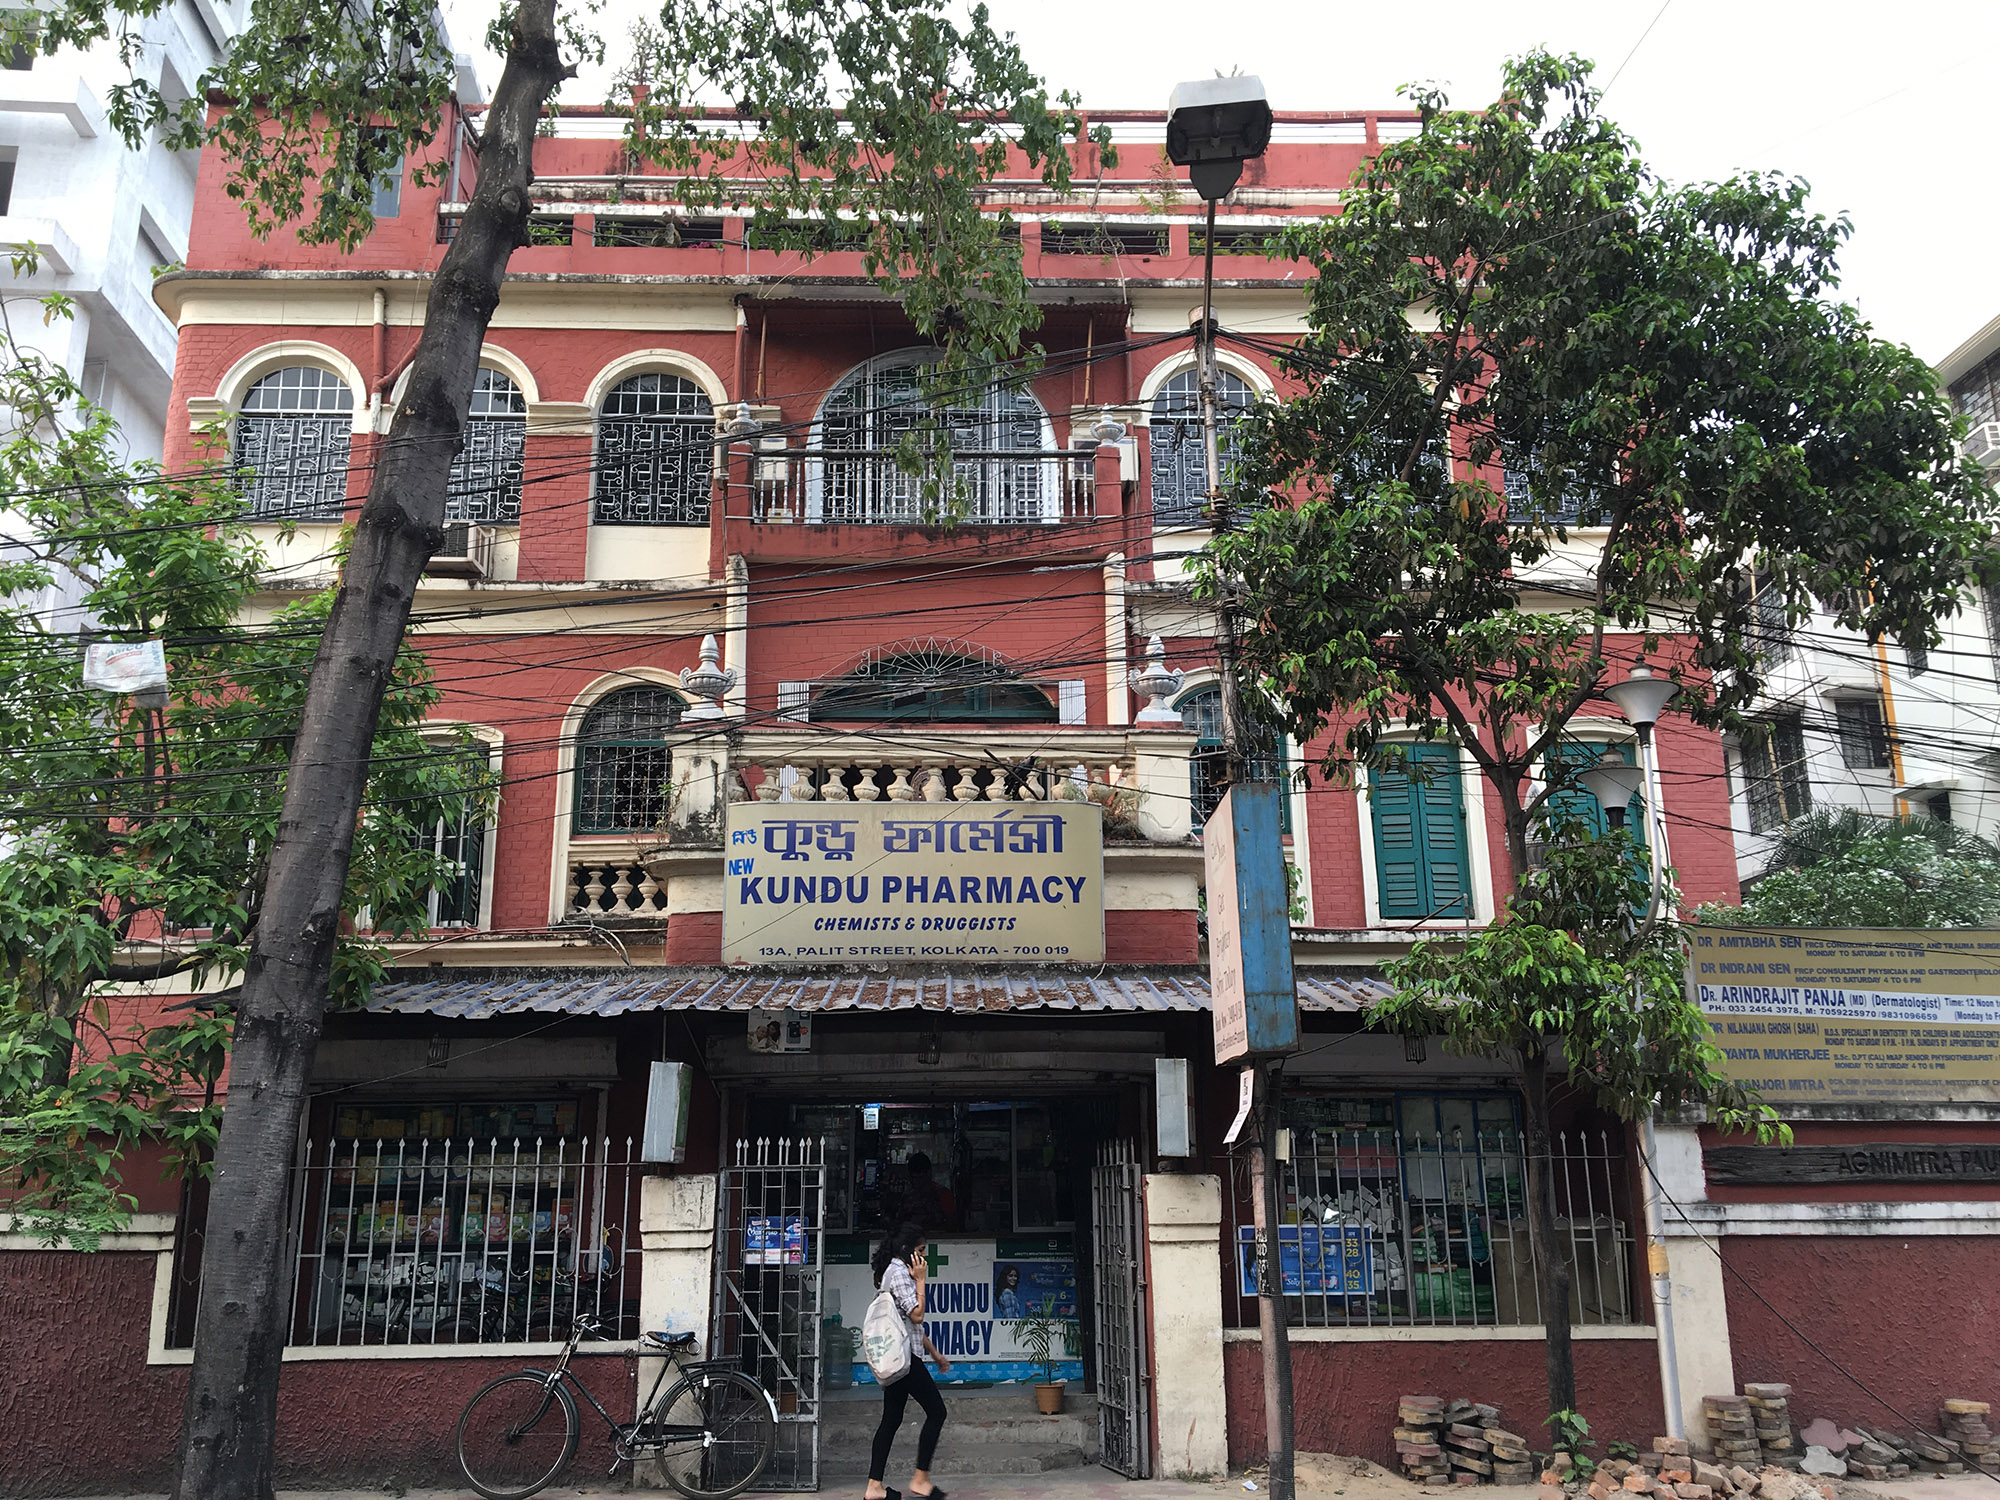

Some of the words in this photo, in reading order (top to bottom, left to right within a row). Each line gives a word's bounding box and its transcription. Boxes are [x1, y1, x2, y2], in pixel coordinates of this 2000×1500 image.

[728, 858, 755, 876] NEW
[740, 876, 869, 905] KUNDU
[882, 876, 1086, 904] PHARMACY
[814, 917, 901, 931] CHEMISTS
[904, 918, 915, 930] &
[921, 917, 1016, 931] DRUGGISTS
[1698, 936, 1713, 947] DR
[1719, 937, 1776, 948] AMITABHA
[1780, 937, 1802, 948] SEN
[759, 947, 792, 957] 13A,
[797, 947, 844, 955] PALIT
[848, 947, 916, 956] STREET,
[921, 946, 999, 955] KOLKATA
[1013, 946, 1040, 954] 700
[1045, 946, 1070, 954] 019
[1701, 963, 1717, 974] DR
[1719, 963, 1765, 974] INDRANI
[1768, 964, 1791, 974] SEN
[1722, 987, 1799, 1005] ARINDRAJIT
[1804, 989, 1846, 1007] PANJA
[1850, 993, 1867, 1008] (MD)
[1872, 993, 1941, 1011] (Dermatologist)
[1944, 997, 1964, 1007] Time:
[1966, 998, 1975, 1007] 12
[1976, 998, 1994, 1007] Noon
[1776, 1007, 1802, 1015] 3978,
[1819, 1008, 1876, 1018] 7059225970
[1954, 1011, 1983, 1022] (Monday
[1985, 1012, 1993, 1020] to
[1727, 1023, 1766, 1034] NILANJANA
[1768, 1023, 1791, 1034] GHOSH
[1879, 1029, 1908, 1037] DENTISTRY
[1910, 1029, 1920, 1037] FOR
[1949, 1039, 1984, 1047] APPOINTMENT
[1764, 1049, 1830, 1060] MUKHERJEE
[1789, 1080, 1825, 1090] MITRA
[1839, 1151, 1956, 1174] AGNIMITRA
[925, 1283, 989, 1314] KUNDU
